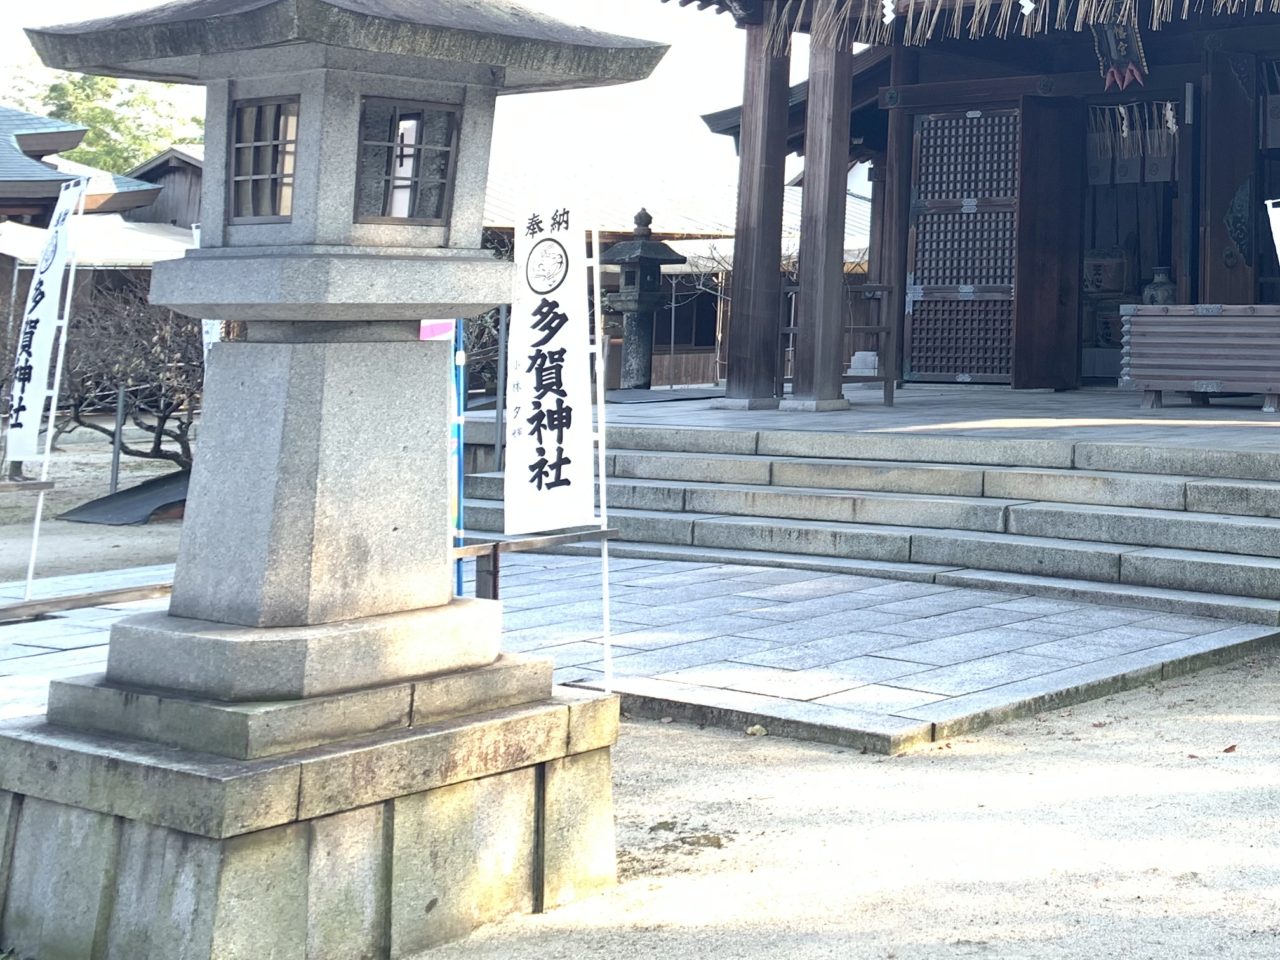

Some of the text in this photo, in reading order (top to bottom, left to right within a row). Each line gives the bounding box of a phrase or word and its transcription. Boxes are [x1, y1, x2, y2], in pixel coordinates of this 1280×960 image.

[526, 208, 570, 239] 奉納
[10, 278, 46, 428] 多賀神社
[526, 297, 573, 491] 多賀神社
